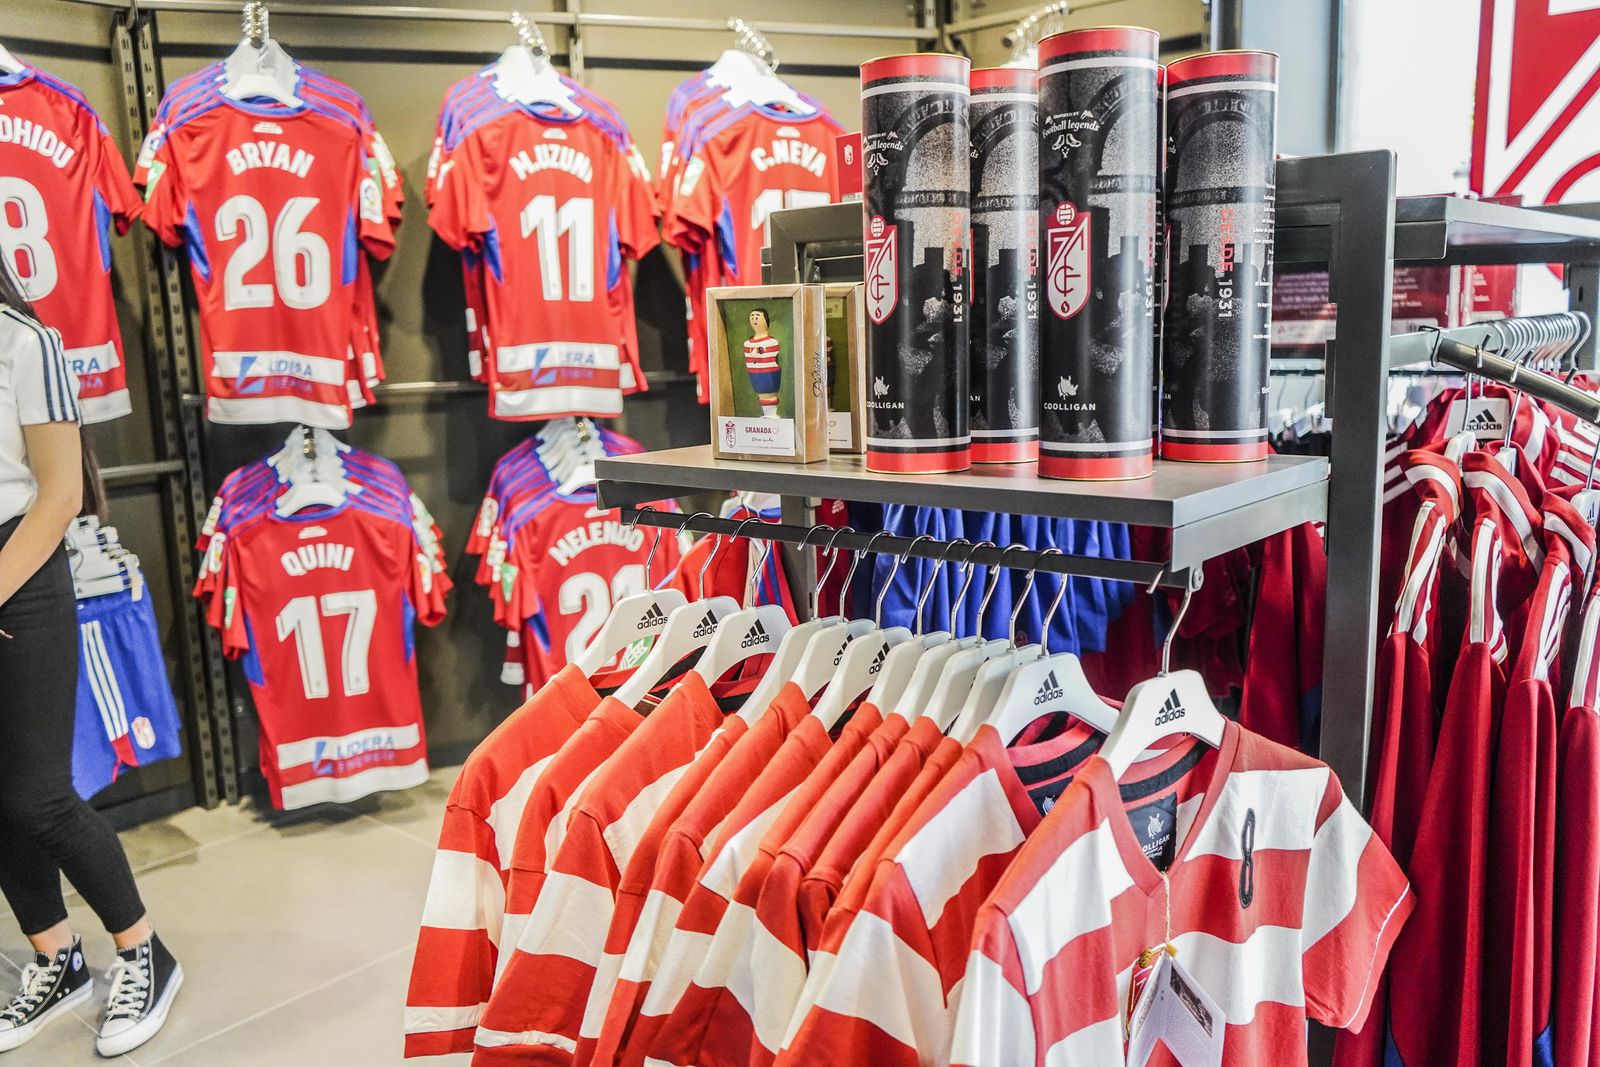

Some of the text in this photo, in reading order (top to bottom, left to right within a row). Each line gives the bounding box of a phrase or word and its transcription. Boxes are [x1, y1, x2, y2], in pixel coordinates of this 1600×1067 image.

[1068, 119, 1101, 132] legends
[225, 141, 314, 179] BRYAN
[751, 139, 827, 178] C.NEVA
[877, 139, 904, 152] legends
[0, 176, 58, 302] 8
[215, 194, 331, 312] 26
[520, 194, 594, 302] 11
[1218, 208, 1236, 318] DESDE 1931
[953, 283, 963, 323] 1931
[1026, 282, 1038, 319] 1931
[1043, 402, 1096, 411] COOLLIGAN
[745, 426, 771, 434] GRANADA
[1466, 421, 1503, 432] adidas
[280, 543, 354, 577] QUINI
[549, 520, 645, 567] MELENDO
[636, 614, 669, 630] adidas
[275, 589, 378, 700] 17
[740, 632, 770, 649] adidas
[1033, 687, 1064, 706] adidas
[1154, 707, 1186, 727] adidas
[1142, 833, 1171, 853] OLLIGAN
[1238, 807, 1256, 909] 8
